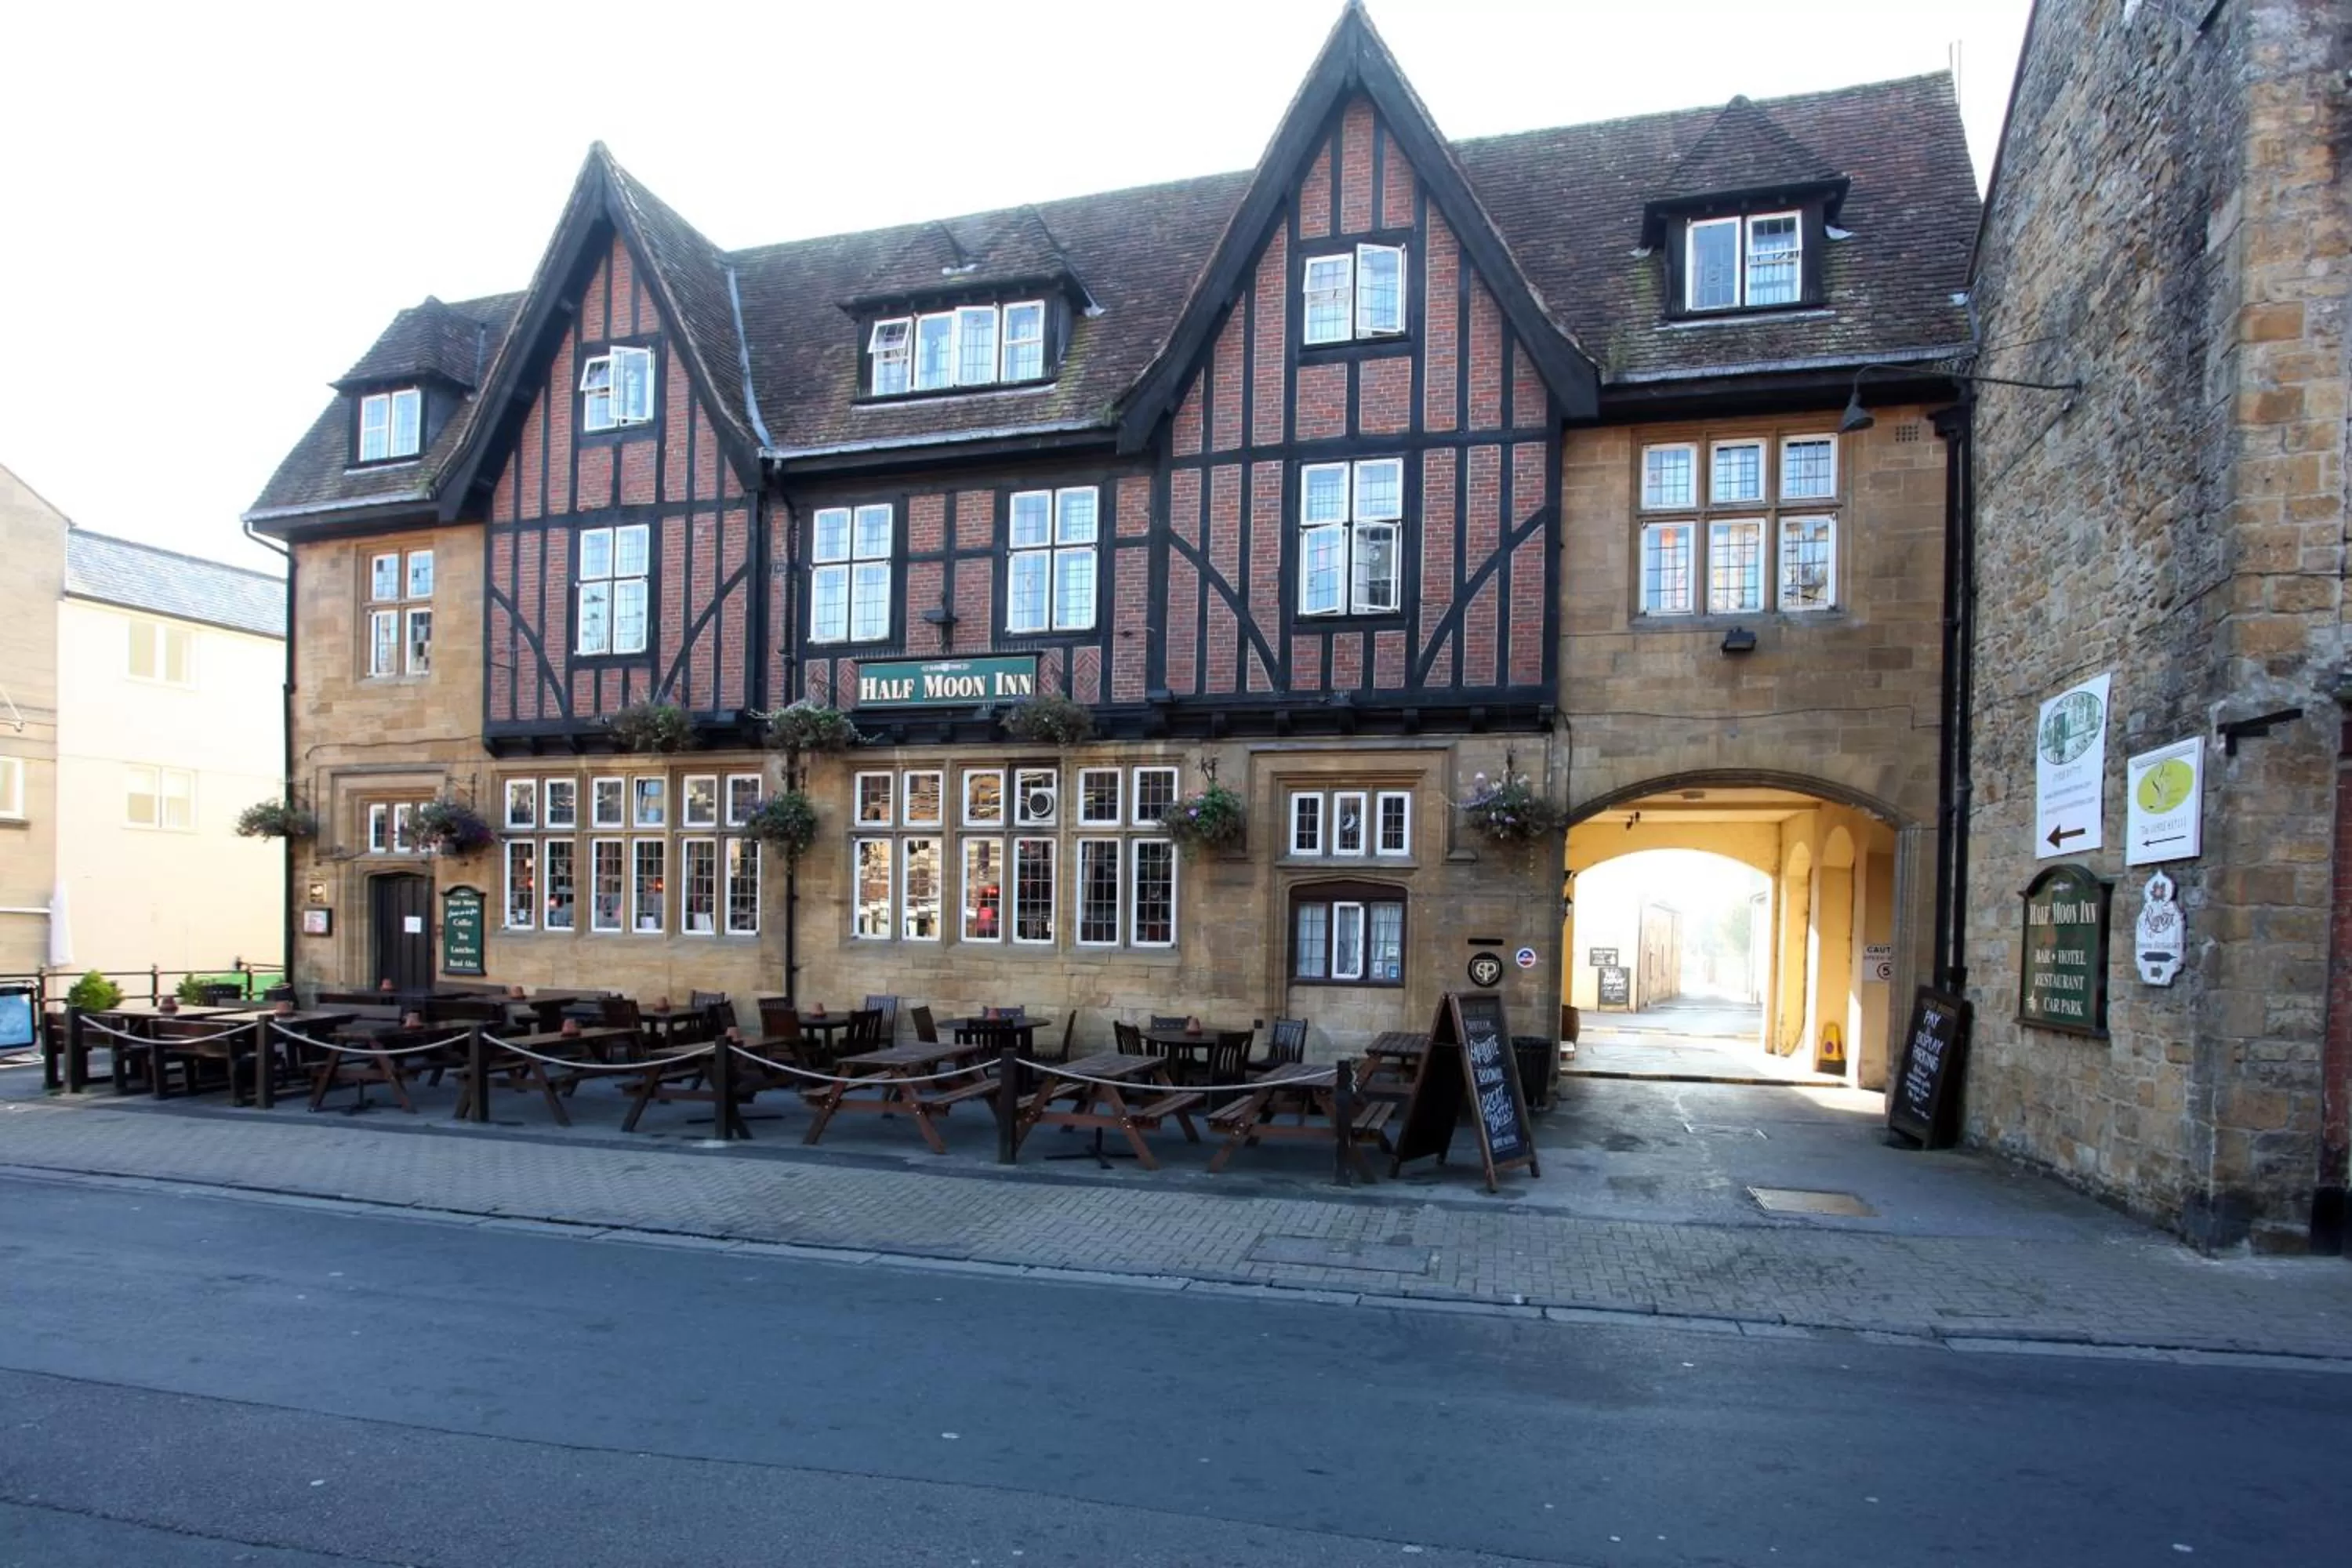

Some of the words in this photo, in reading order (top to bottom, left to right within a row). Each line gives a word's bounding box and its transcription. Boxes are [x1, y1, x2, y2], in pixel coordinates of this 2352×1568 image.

[860, 677, 915, 700] HALF
[924, 674, 986, 698] MOON
[995, 672, 1032, 695] INN
[2029, 903, 2050, 926] HALF
[2053, 902, 2078, 924] MOON
[2080, 900, 2097, 924] INN
[2034, 949, 2050, 964] BAR
[2058, 949, 2086, 965] HOTEL
[2034, 972, 2085, 991] RESTAURANT
[2043, 996, 2060, 1013] CAR
[2061, 999, 2083, 1017] PARK
[1924, 1010, 1942, 1029] PAY
